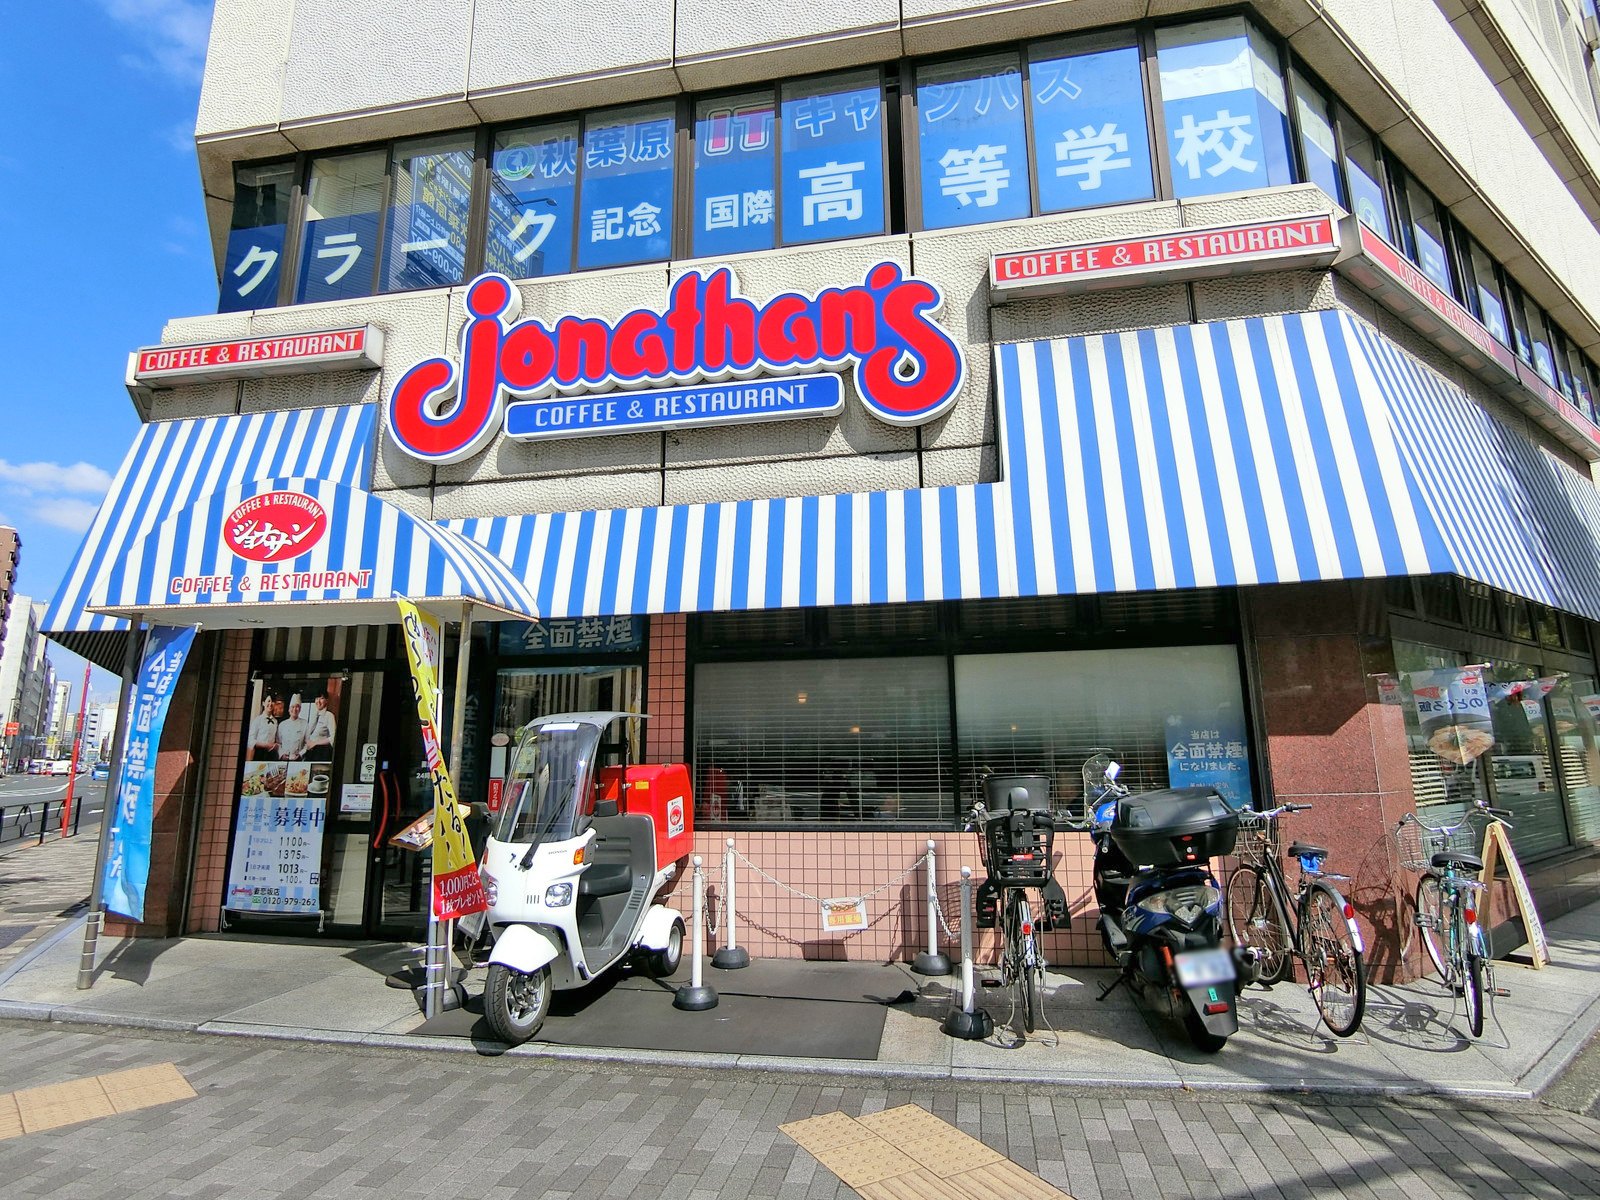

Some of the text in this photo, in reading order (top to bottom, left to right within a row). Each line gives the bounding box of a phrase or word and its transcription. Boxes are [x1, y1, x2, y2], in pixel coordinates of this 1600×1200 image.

[1005, 223, 1321, 279] COFFEE & RESTAURANT
[145, 332, 359, 371] COFFEE & RESTAURANT
[535, 383, 809, 428] COFFEE & RESTAURANT
[230, 494, 324, 523] COFFEE & RESTAURANT
[232, 519, 317, 559] ジョナサン
[171, 570, 372, 594] COFFEE & RESTAURANT
[521, 616, 633, 650] 全面禁煙
[1190, 730, 1220, 739] 当店は
[1170, 741, 1244, 760] 全面禁煙
[1180, 761, 1241, 771] になりました。
[274, 807, 325, 827] 募集中
